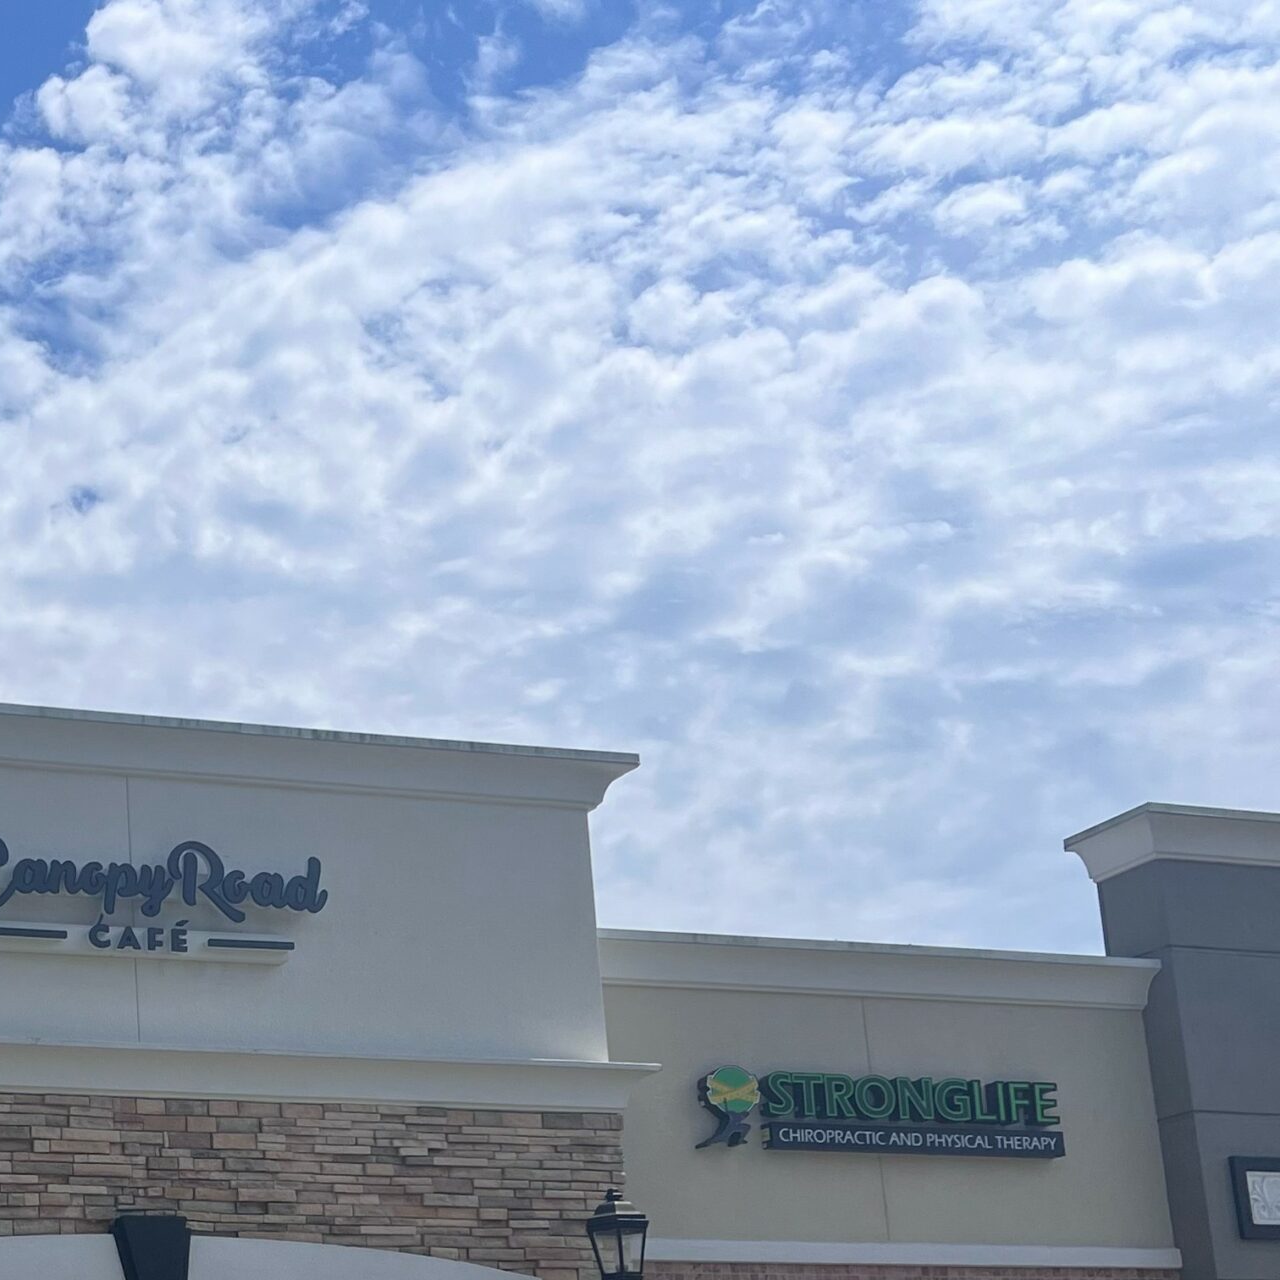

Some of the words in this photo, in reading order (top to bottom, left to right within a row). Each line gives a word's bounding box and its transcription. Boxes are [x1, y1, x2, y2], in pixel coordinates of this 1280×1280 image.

[167, 840, 328, 923] Road
[88, 919, 189, 953] CAFÉ
[764, 1070, 1061, 1125] STRONGLIFE
[778, 1127, 885, 1146] CHIROPRACTIC
[889, 1131, 923, 1147] AND
[926, 1132, 992, 1149] PHYSICAL
[994, 1134, 1056, 1151] THERAPY
